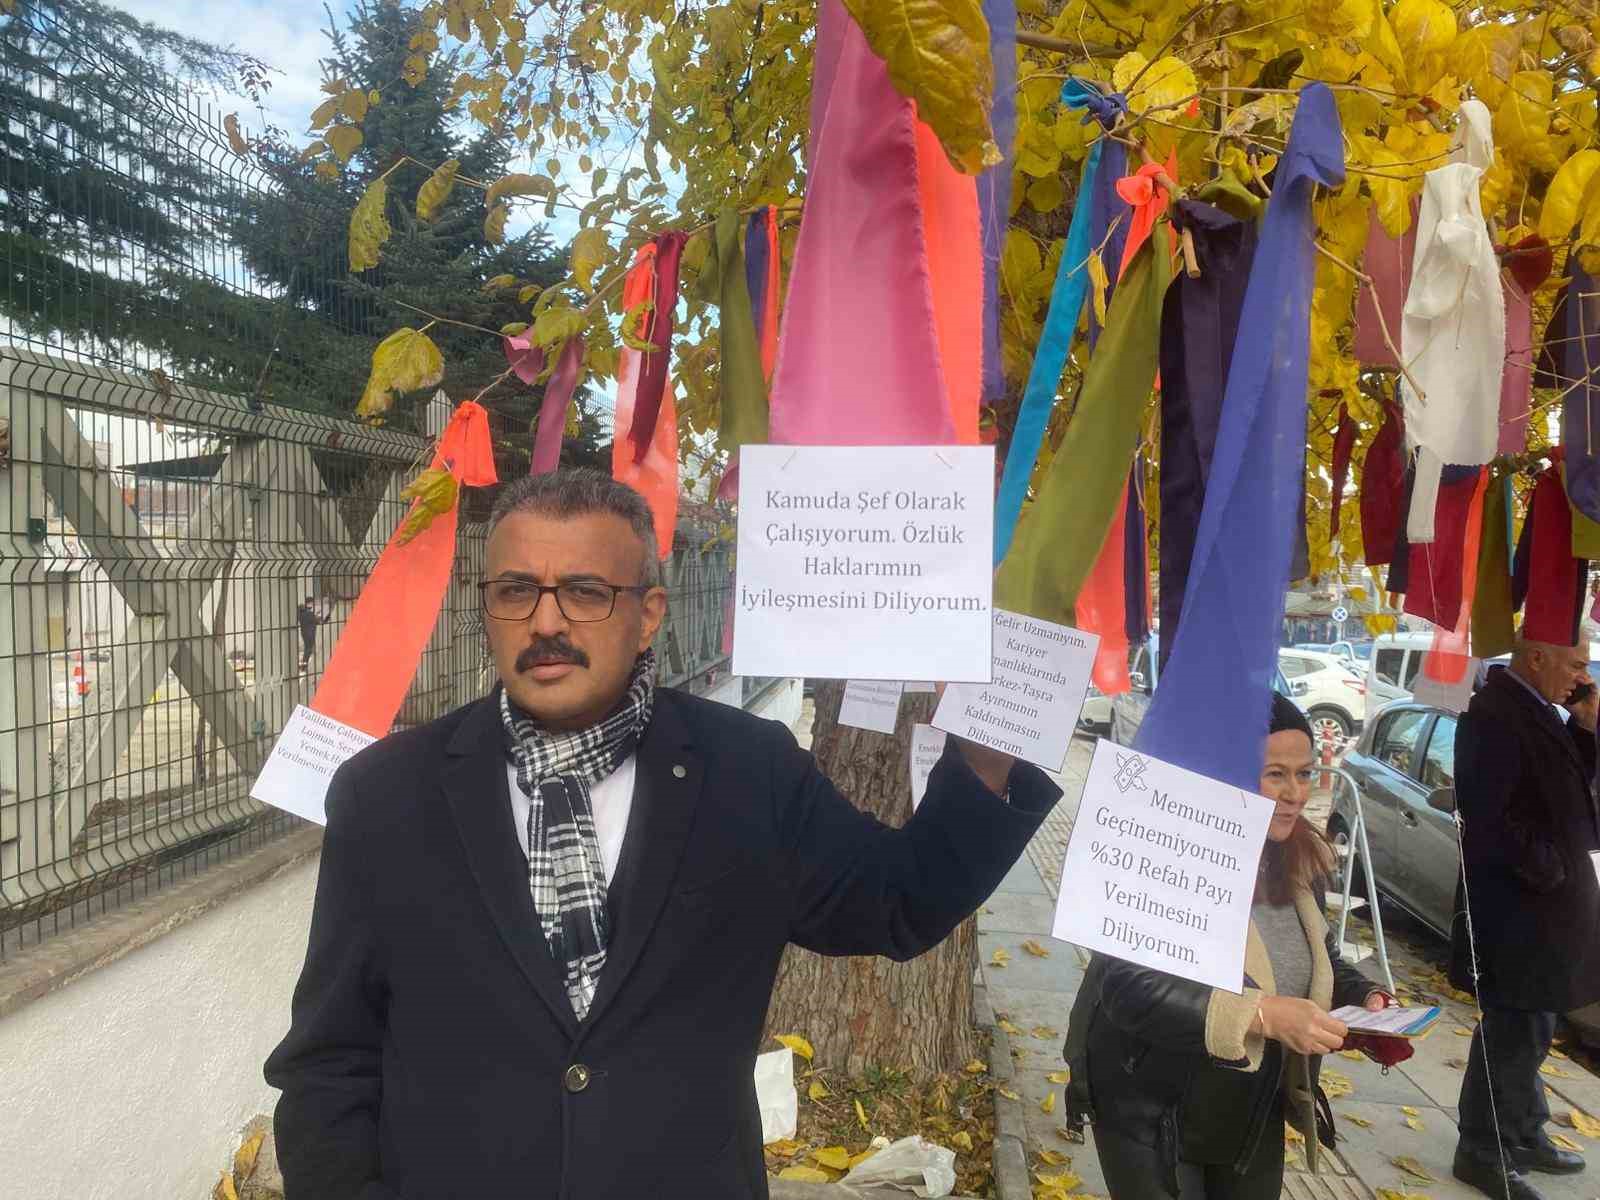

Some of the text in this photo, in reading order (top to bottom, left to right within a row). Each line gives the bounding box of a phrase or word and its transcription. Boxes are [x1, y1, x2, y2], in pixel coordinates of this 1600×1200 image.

[766, 490, 966, 514] Kamuda Şef Olarak
[766, 521, 964, 547] Çalışıyorum. Özlük
[804, 556, 922, 577] Haklarımın
[741, 585, 987, 614] İyileşmesini Diliyorum.
[995, 615, 1087, 649] Gelir Uzmanıyım.
[1006, 638, 1048, 660] Kariyer
[992, 656, 1067, 686] manlıklarında
[992, 675, 1054, 703] rkez-Taşra
[967, 726, 1025, 757] Diliyorum.
[1150, 789, 1246, 839] Memurum.
[1096, 806, 1241, 872] Geçinemiyorum.
[1090, 840, 1232, 905] %30 Refah Payı
[1104, 881, 1209, 932] Verilmesini
[1102, 917, 1200, 965] Diliyorum.
